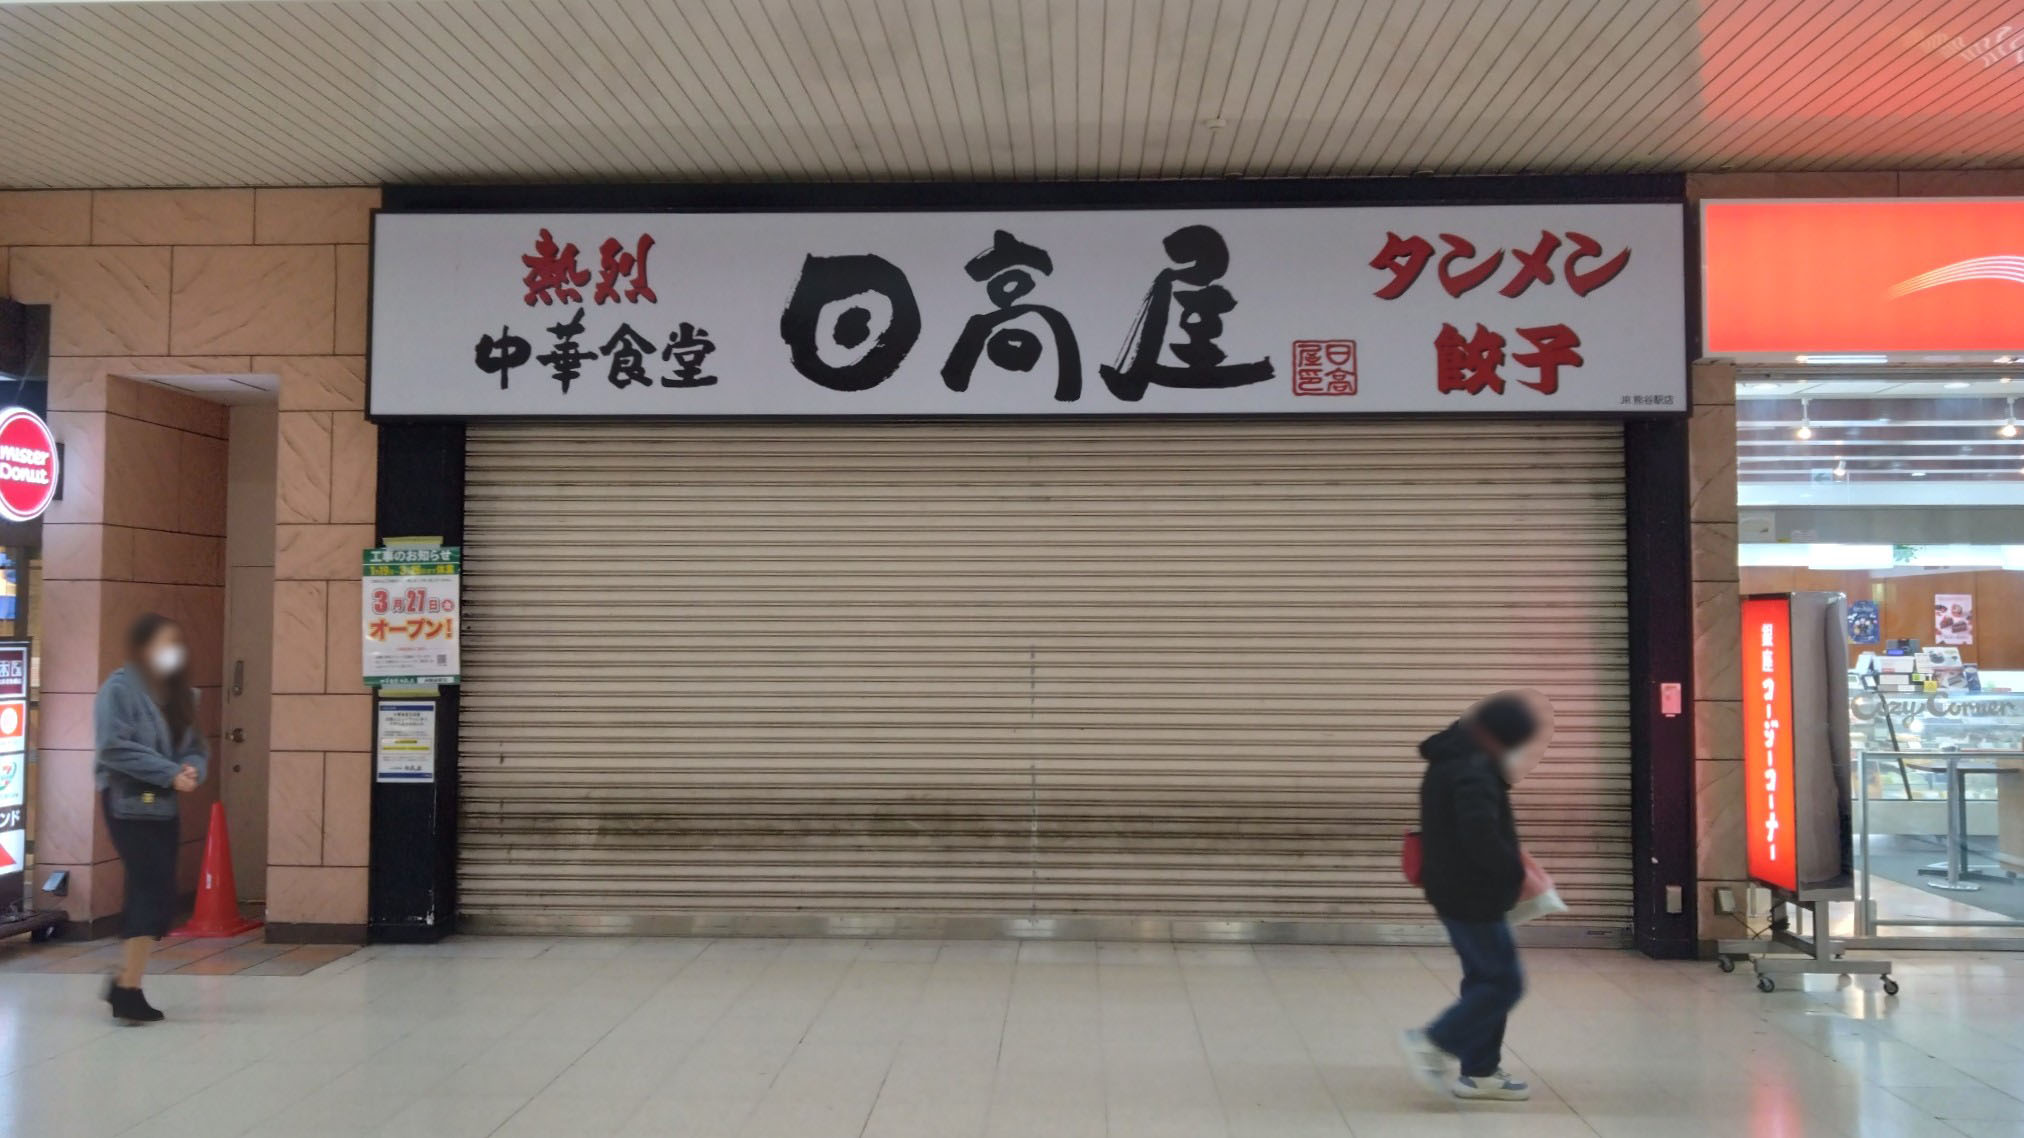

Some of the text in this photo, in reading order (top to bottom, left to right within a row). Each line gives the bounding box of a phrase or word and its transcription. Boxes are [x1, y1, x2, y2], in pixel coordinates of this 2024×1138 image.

[522, 228, 658, 305] 熱烈
[1369, 231, 1630, 299] タンメン
[780, 223, 1276, 402] 日高屋
[475, 307, 718, 395] 中華食堂
[1433, 323, 1584, 396] 餃子
[0, 462, 49, 485] Donut
[370, 549, 452, 563] 工事のお知らせ
[1927, 691, 2015, 717] Corner
